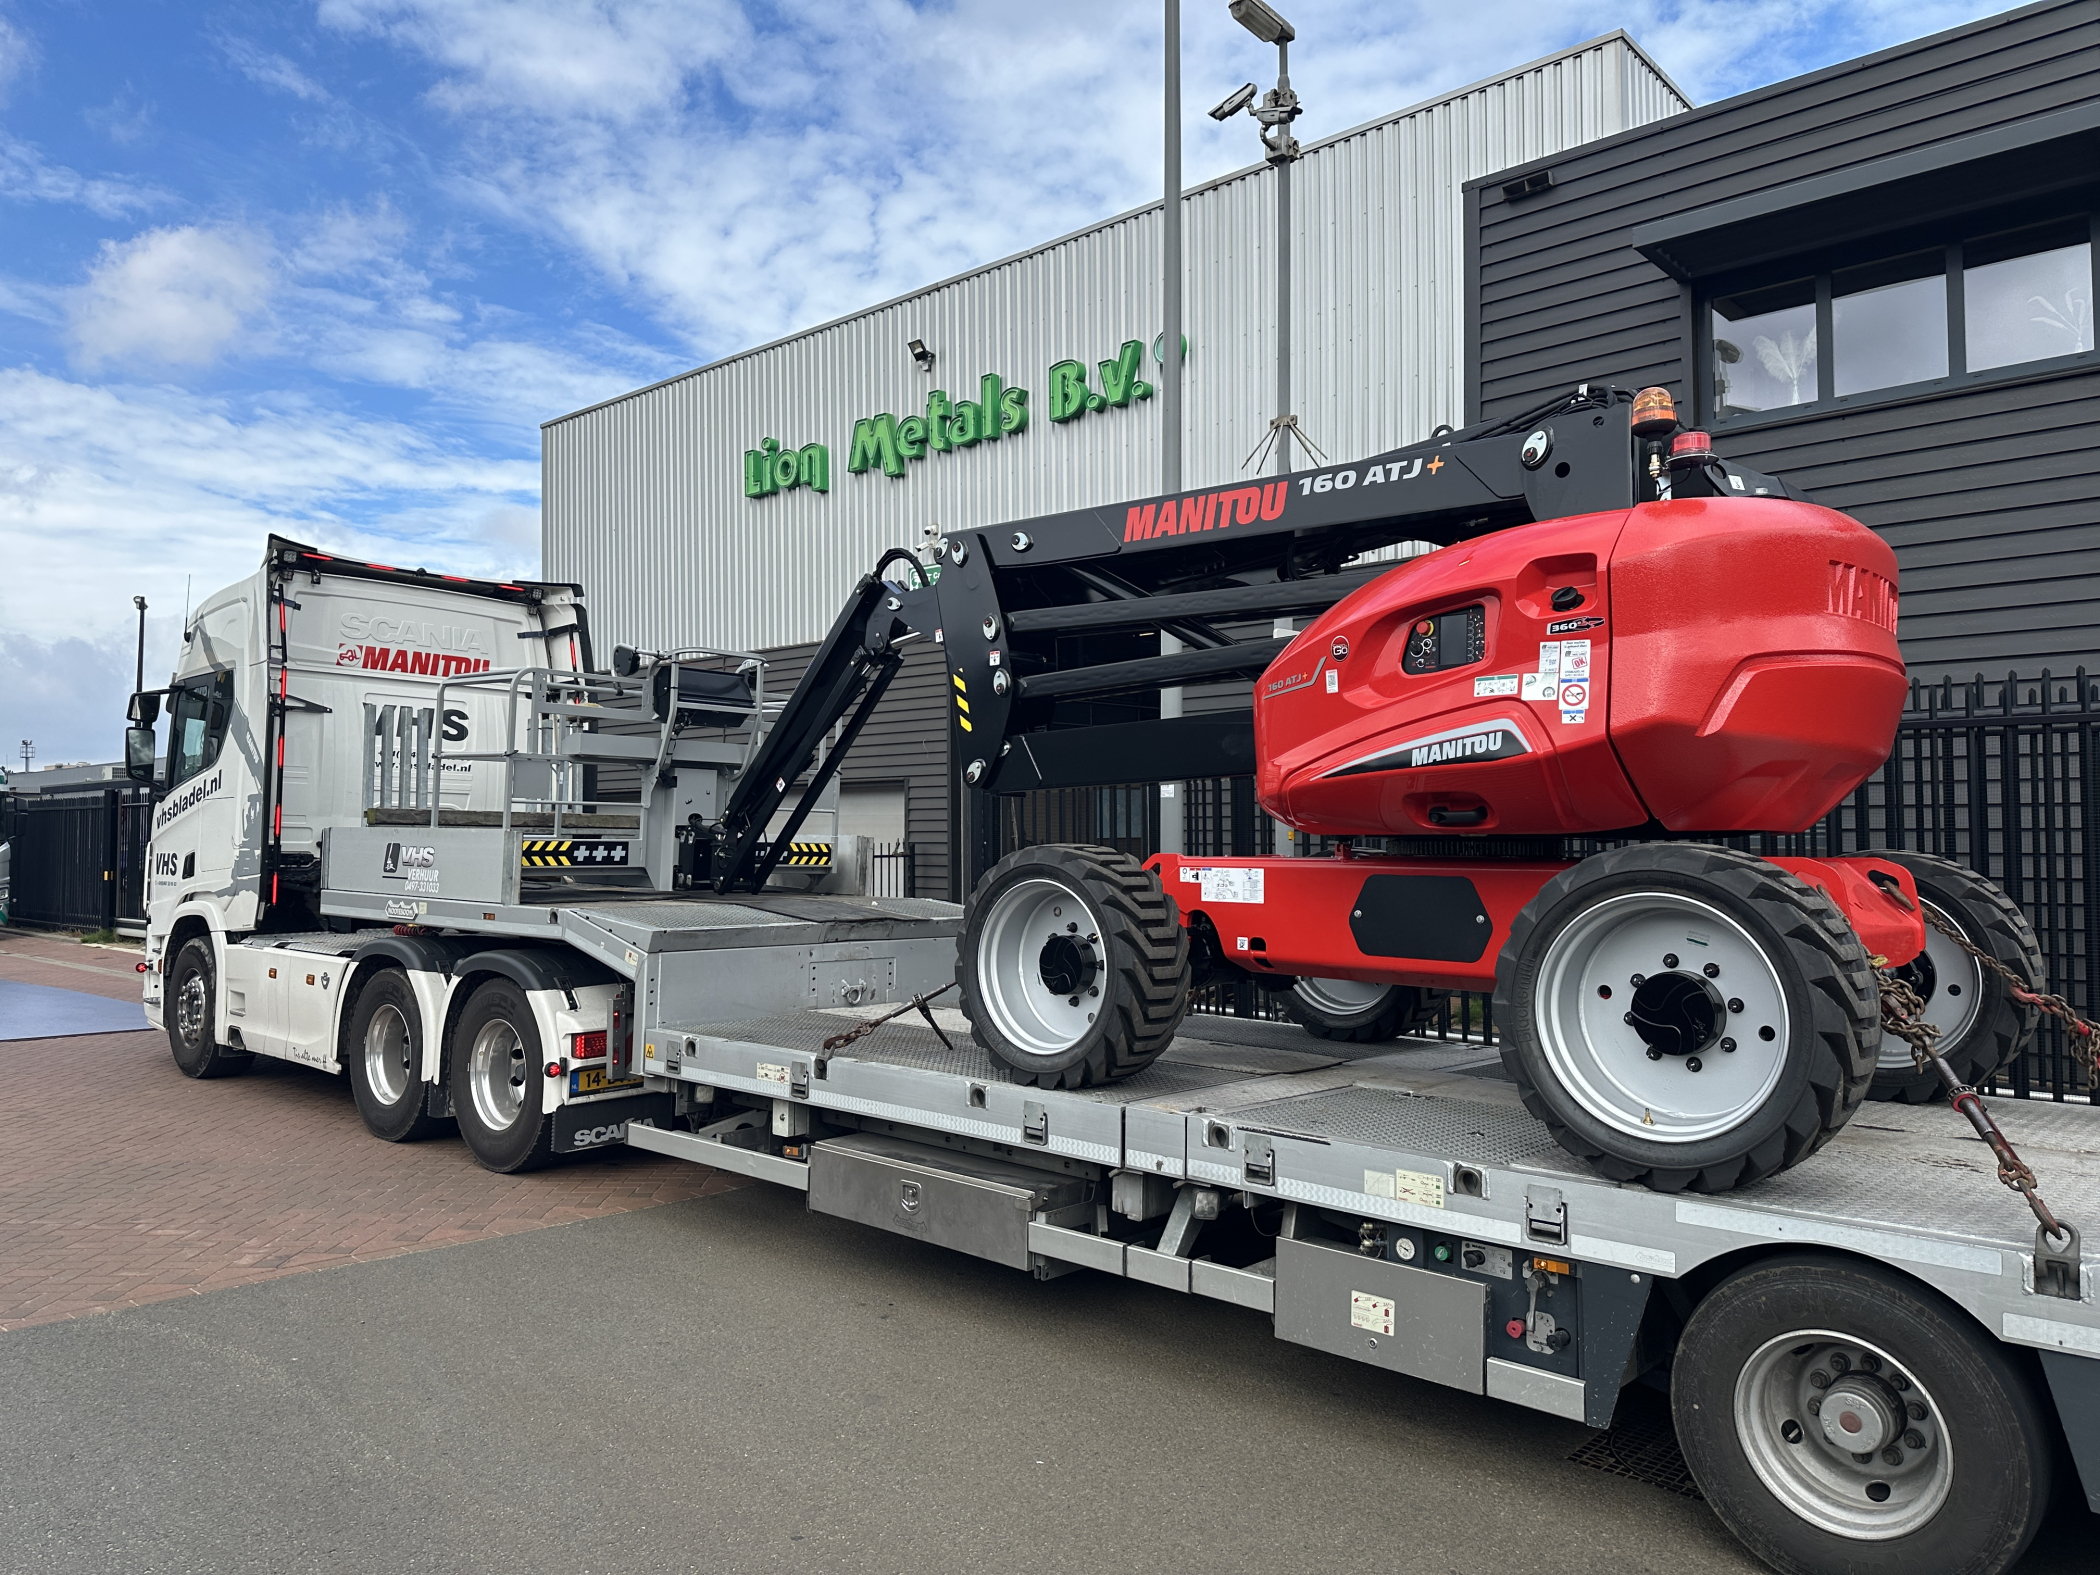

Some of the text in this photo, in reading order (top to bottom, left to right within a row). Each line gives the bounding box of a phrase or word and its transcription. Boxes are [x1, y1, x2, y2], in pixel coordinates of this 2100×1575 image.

[744, 339, 1154, 499] Lion Metals B.V.
[1122, 481, 1289, 543] MANITOU
[1298, 470, 1357, 496] 160
[339, 612, 489, 655] SCANIA
[361, 645, 491, 678] MANITOU
[1268, 680, 1284, 692] 160
[1411, 731, 1503, 769] MANITOU
[156, 769, 222, 830] vhsbladel.nl
[156, 852, 178, 876] VHS
[401, 845, 436, 869] VHS
[404, 880, 440, 894] 0497-331033
[407, 867, 440, 882] VERHUUR
